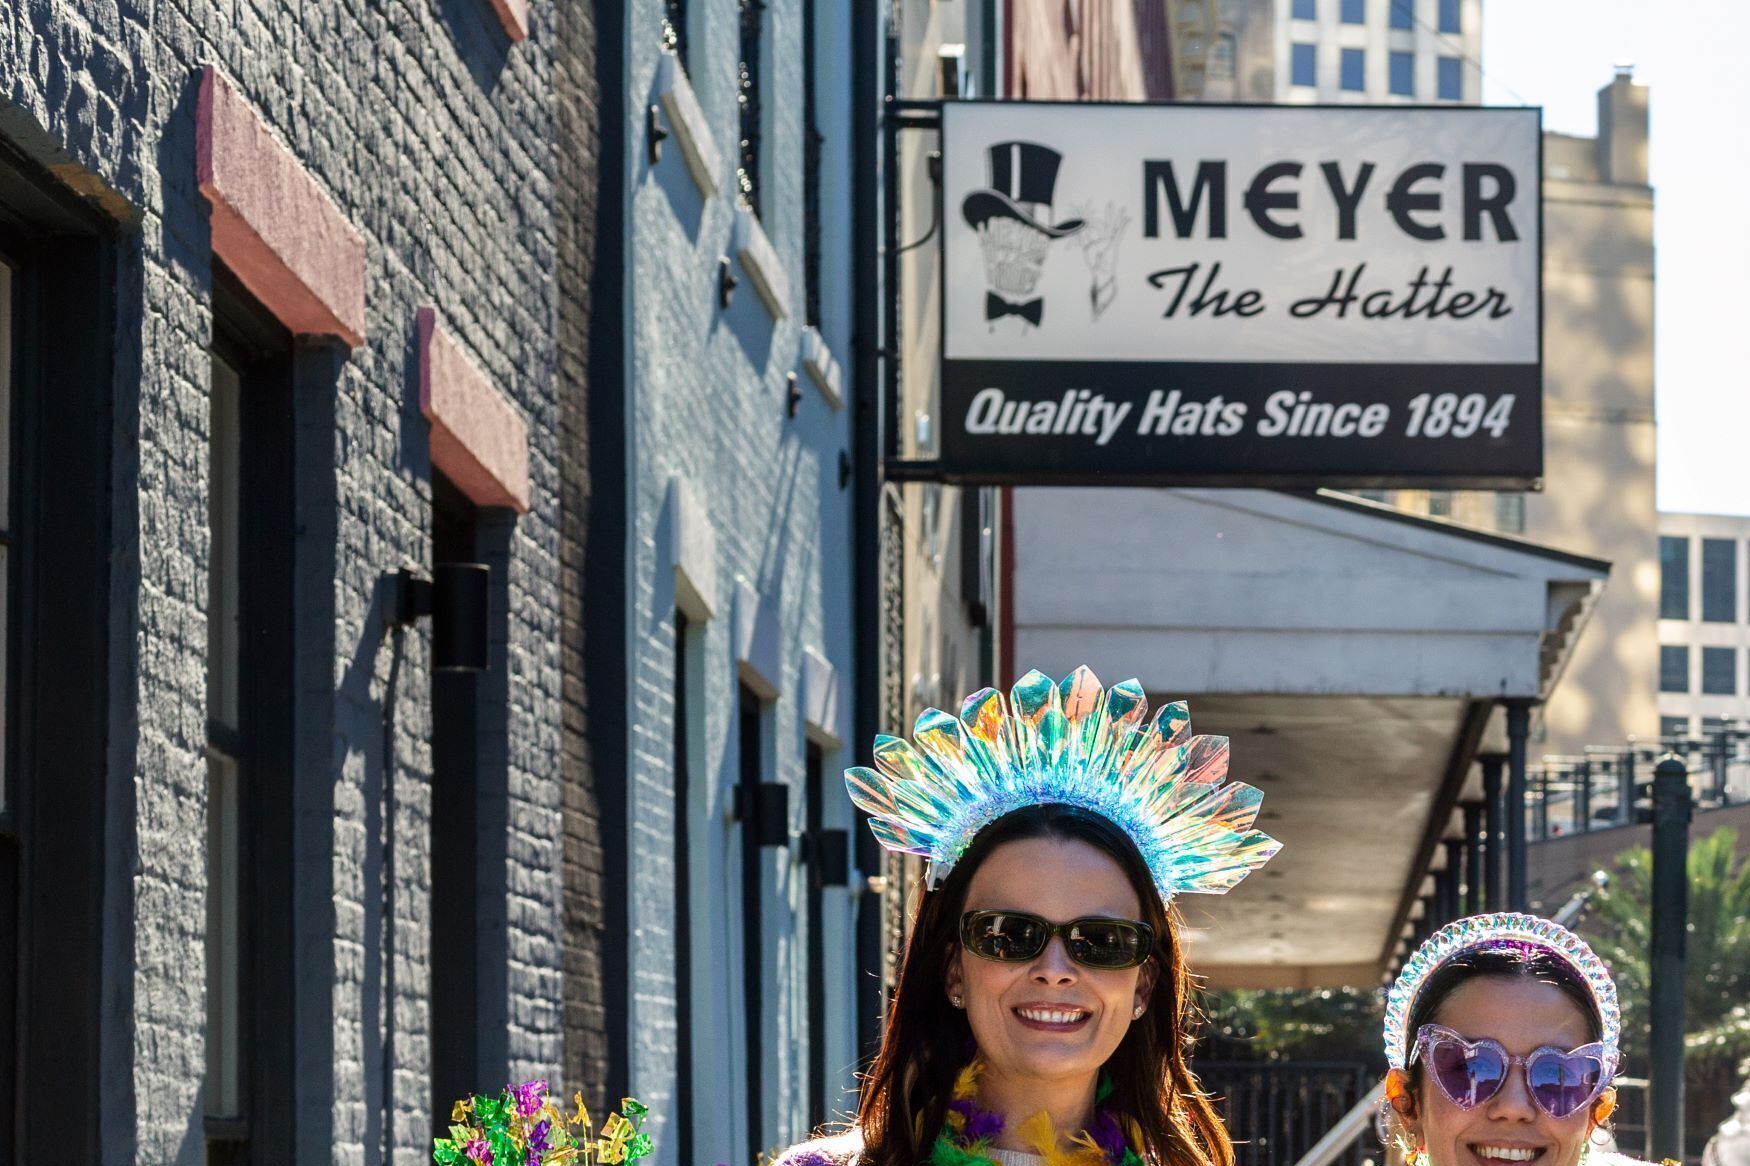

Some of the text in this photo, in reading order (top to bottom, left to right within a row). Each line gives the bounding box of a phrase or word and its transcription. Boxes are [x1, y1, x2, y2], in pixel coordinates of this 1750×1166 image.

[1143, 160, 1520, 243] MEYER
[1147, 261, 1513, 321] The Hatter
[964, 387, 1515, 445] Quality Hats Since 1894
